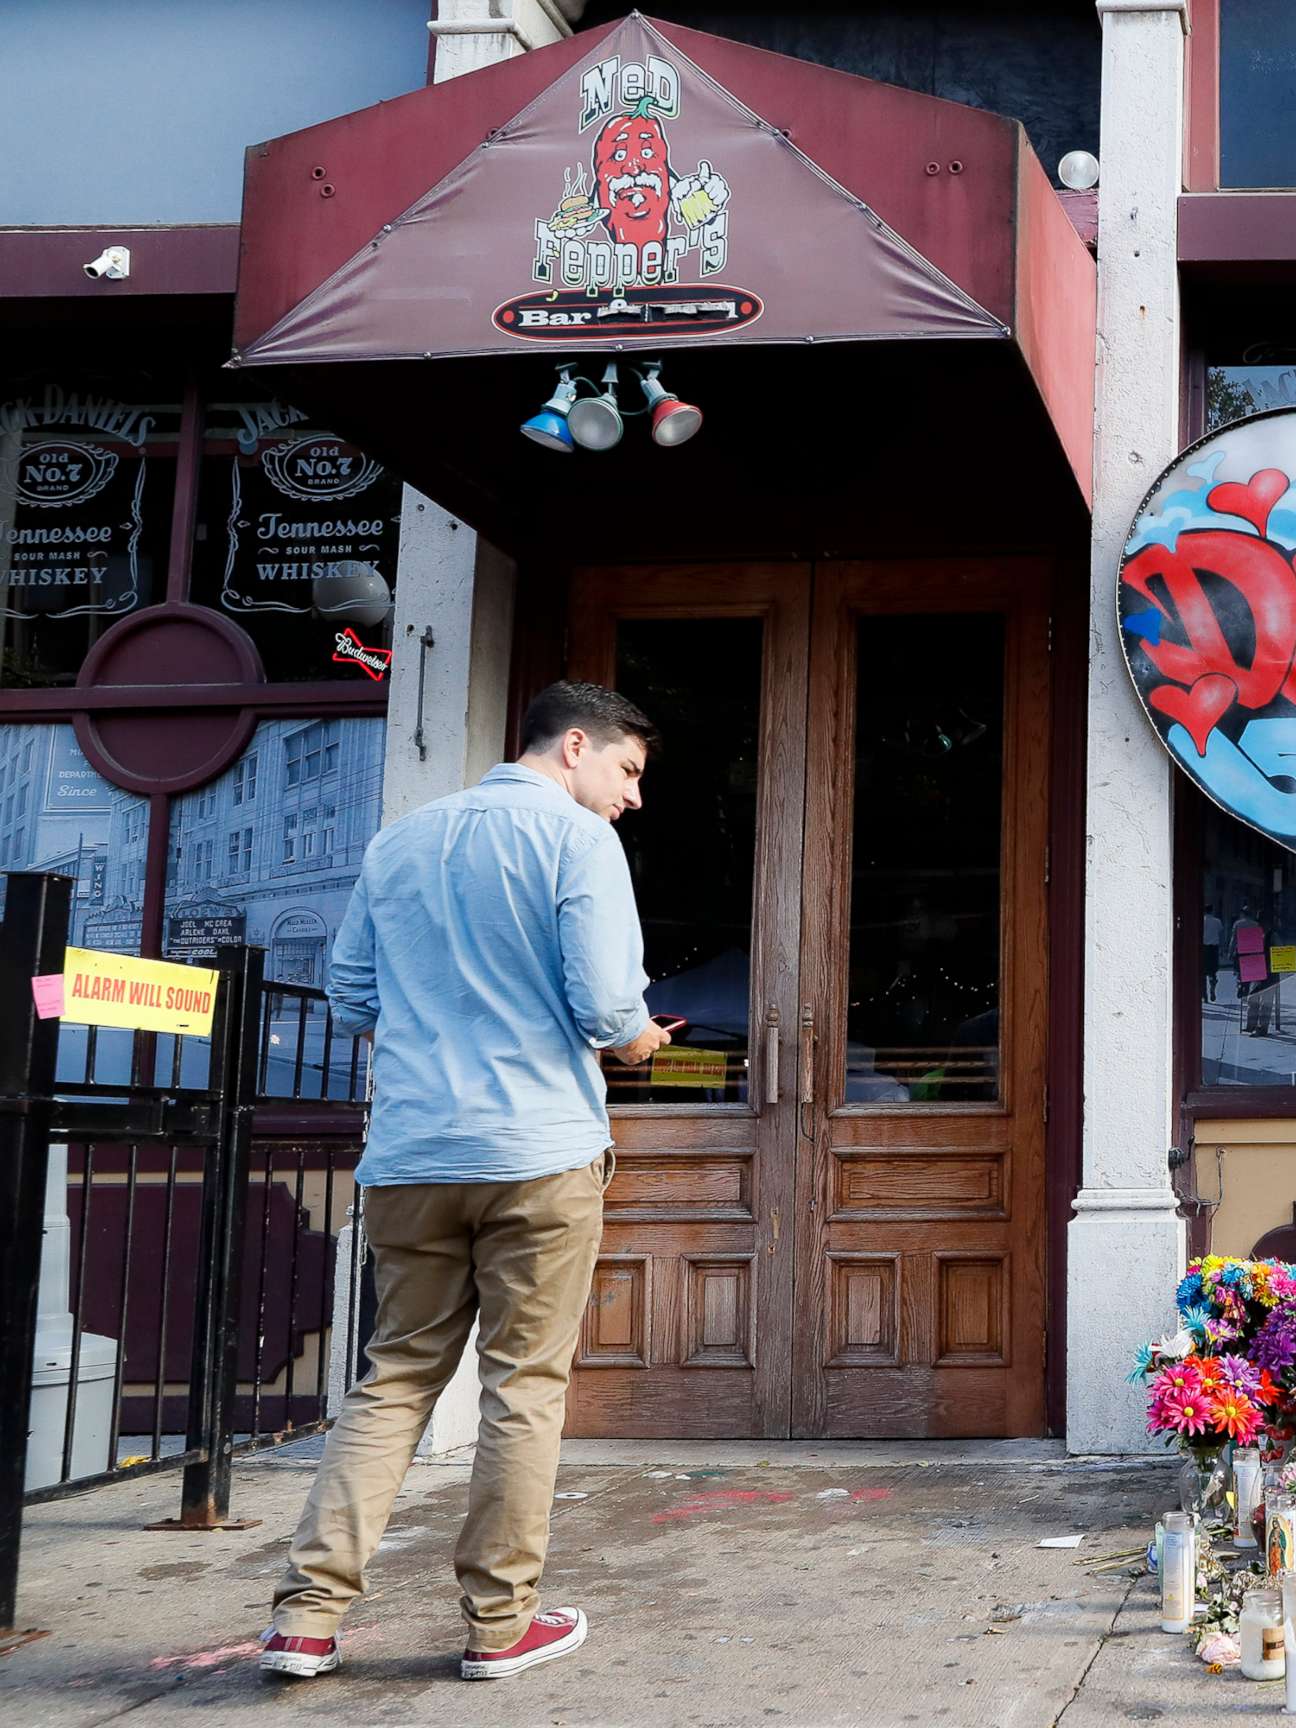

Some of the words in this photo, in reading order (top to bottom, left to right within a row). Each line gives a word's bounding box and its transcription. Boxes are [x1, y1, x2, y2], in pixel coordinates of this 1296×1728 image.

[518, 310, 592, 326] Bar
[40, 453, 69, 463] Old
[310, 447, 339, 457] Old
[24, 464, 82, 483] No.7
[295, 457, 353, 476] No.7
[307, 477, 340, 485] BRAND
[257, 512, 384, 540] Tennessee
[14, 552, 44, 561] SOUR
[49, 551, 81, 560] MASH
[286, 545, 316, 554] SOUR
[320, 545, 352, 554] MASH
[256, 560, 381, 581] WHISKEY
[334, 631, 389, 671] Budweiser
[57, 784, 98, 797] Since
[72, 973, 127, 1004] ALARM
[129, 981, 162, 1008] WILL
[166, 986, 212, 1015] SOUND
